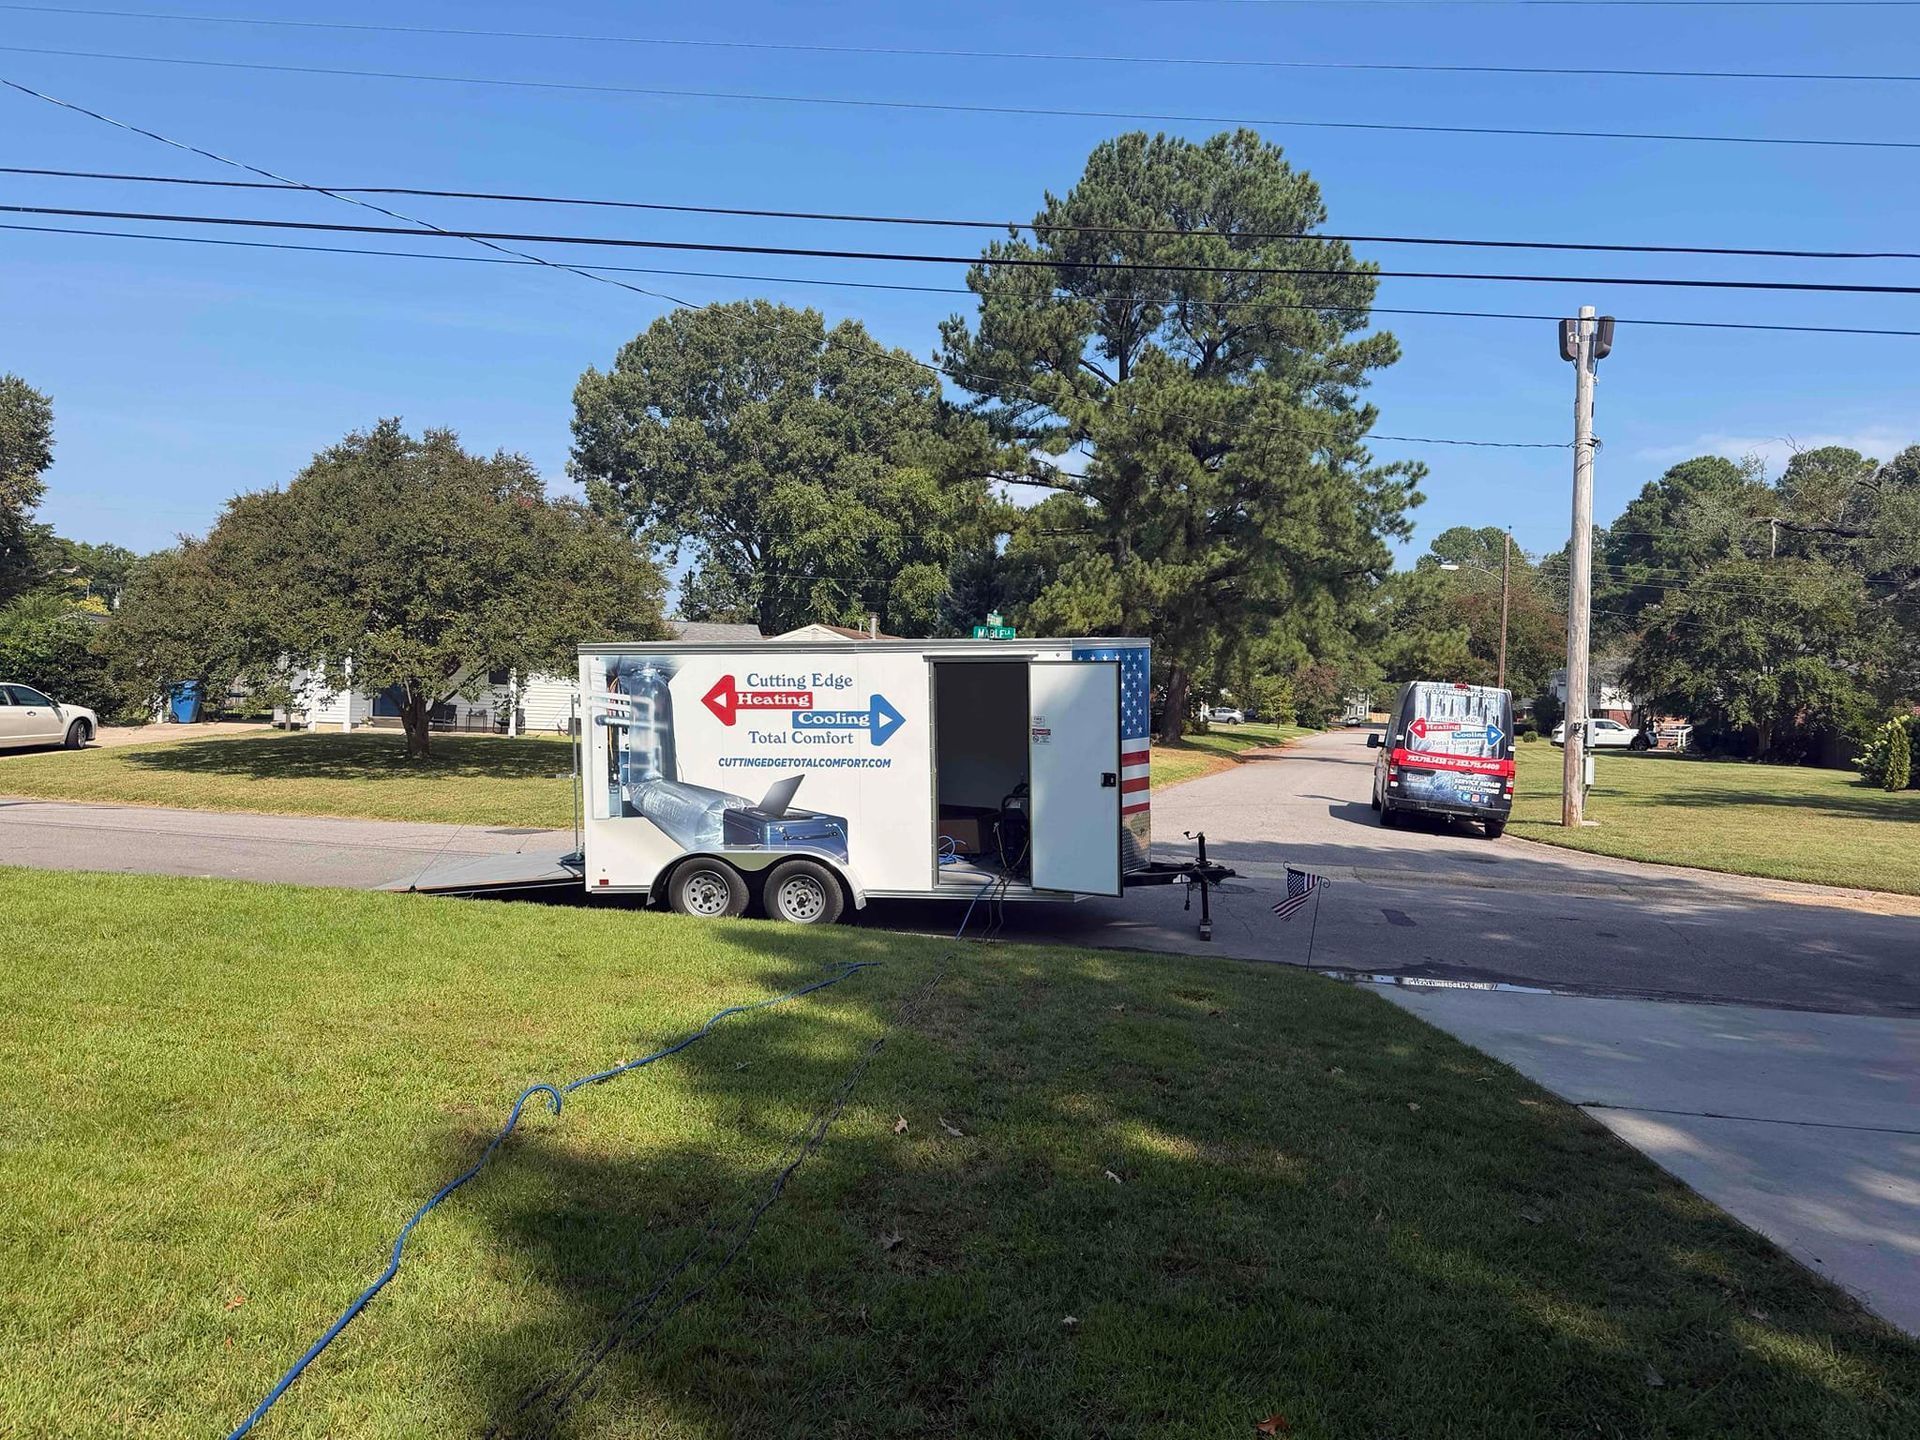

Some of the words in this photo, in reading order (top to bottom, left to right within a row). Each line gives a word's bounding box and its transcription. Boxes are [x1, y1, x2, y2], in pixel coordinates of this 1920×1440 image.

[977, 628, 1004, 638] MABLE
[746, 673, 807, 690] Cutting
[812, 673, 853, 690] Edge
[736, 693, 810, 707] Heating
[798, 712, 870, 727] Cooling
[748, 731, 786, 744] Total
[791, 731, 854, 744] Comfort
[718, 757, 892, 768] CUTTINGEDGETOTALCOMFORT.COM
[1454, 778, 1479, 786] SERVICE
[1479, 780, 1501, 789] REPAIR
